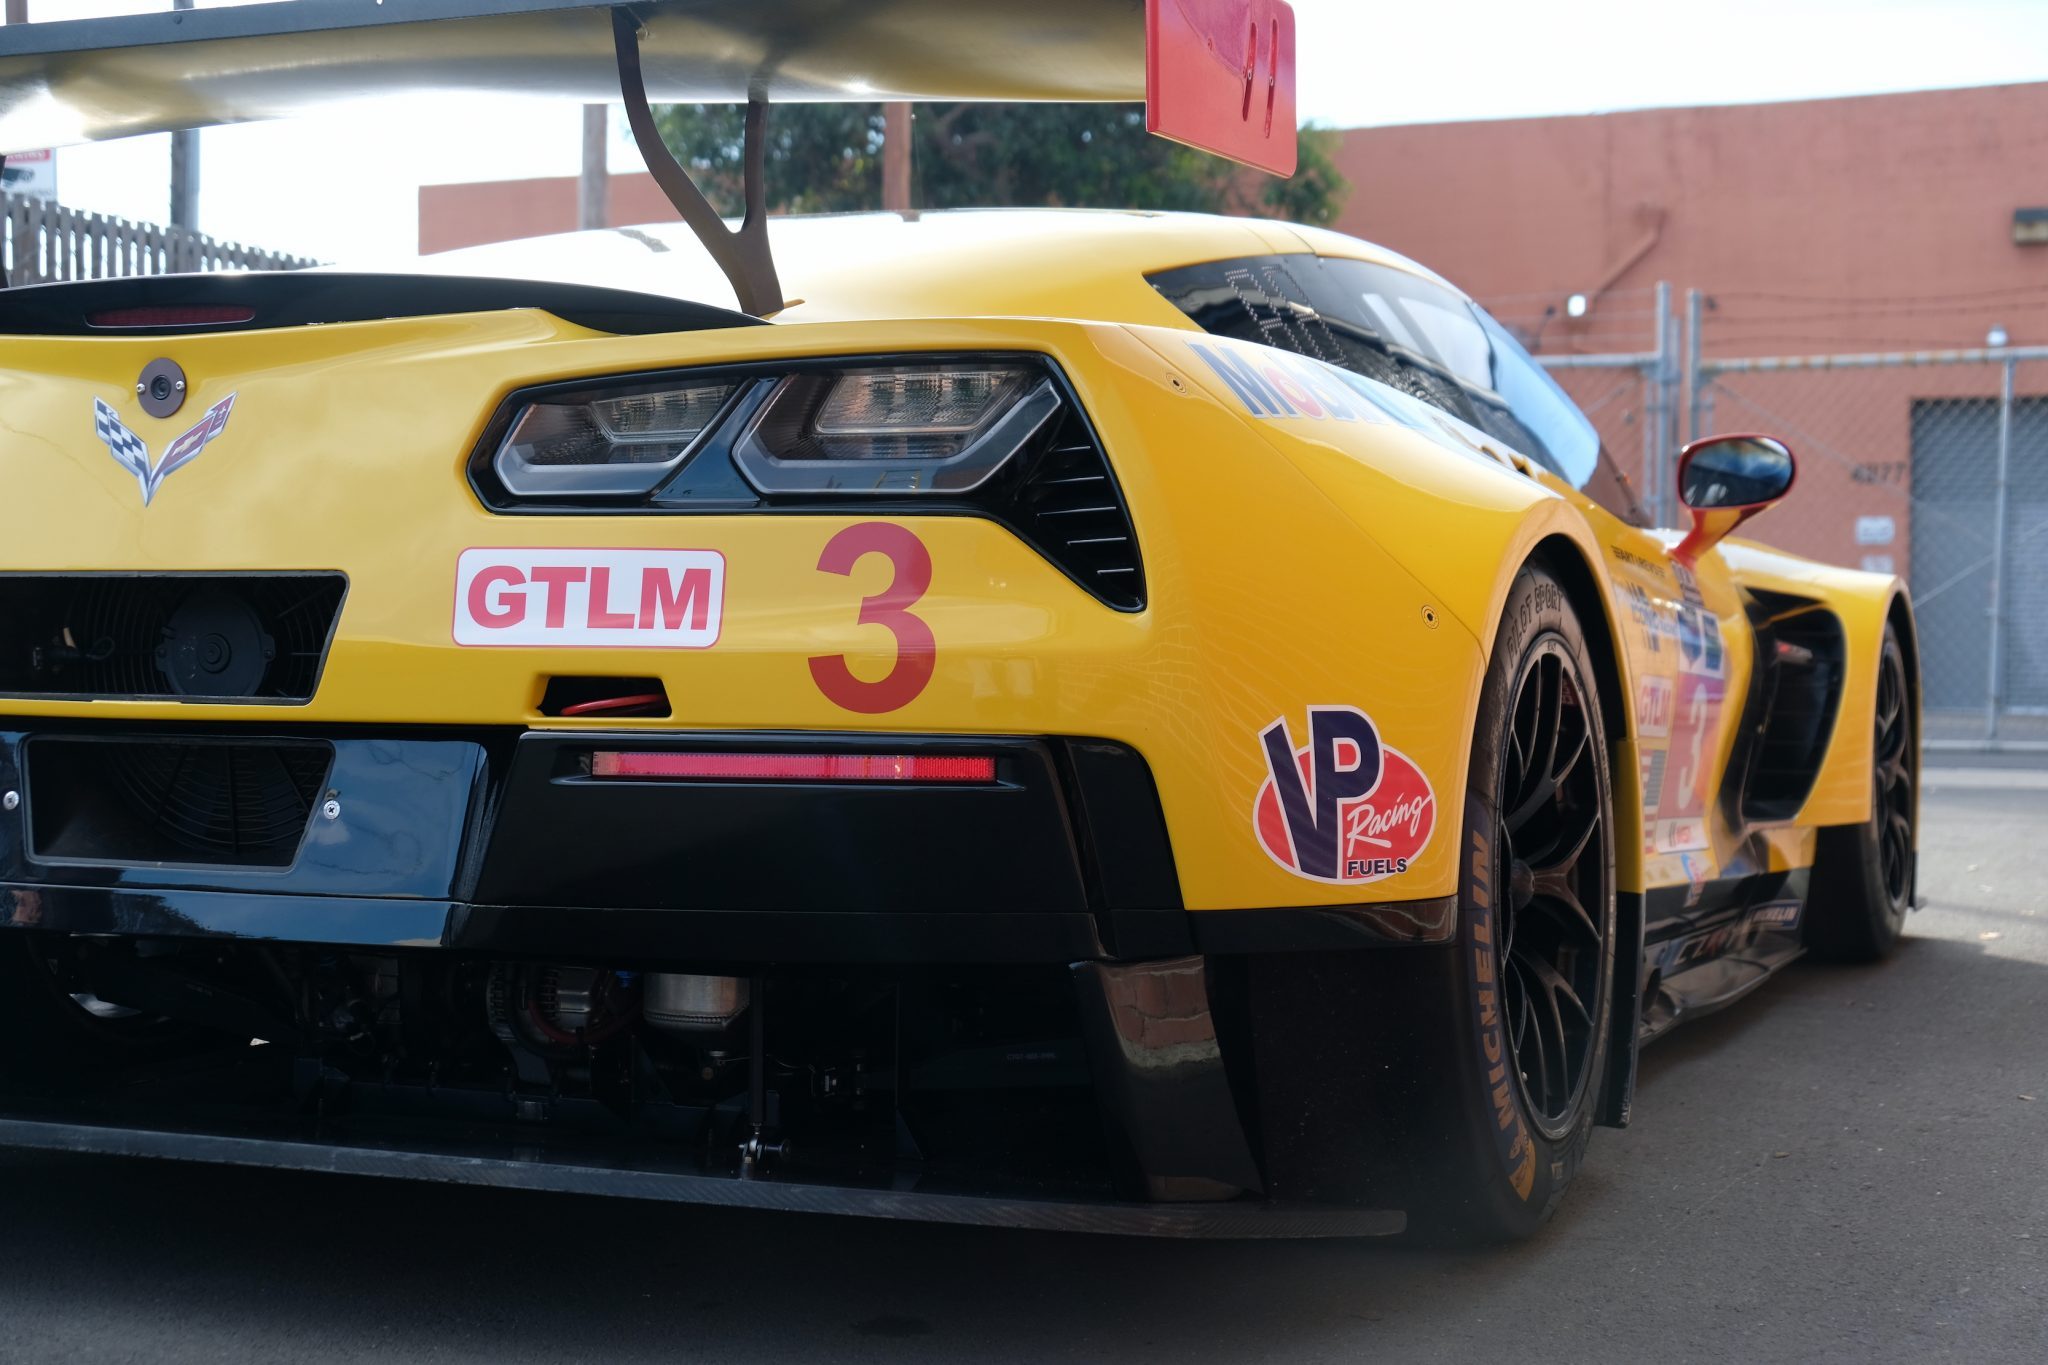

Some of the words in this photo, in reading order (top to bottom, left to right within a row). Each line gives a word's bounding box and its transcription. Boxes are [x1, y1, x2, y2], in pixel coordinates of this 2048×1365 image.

[467, 564, 712, 631] GTLM
[807, 521, 937, 714] 3
[1507, 593, 1533, 669] PILOT
[1534, 583, 1564, 614] SPORT
[1640, 686, 1671, 727] GTLM
[1678, 683, 1708, 810] 3
[1261, 708, 1382, 880] VP
[1347, 792, 1432, 858] Racing
[1347, 858, 1408, 877] FUELS
[1473, 830, 1518, 1131] MICHELIN
